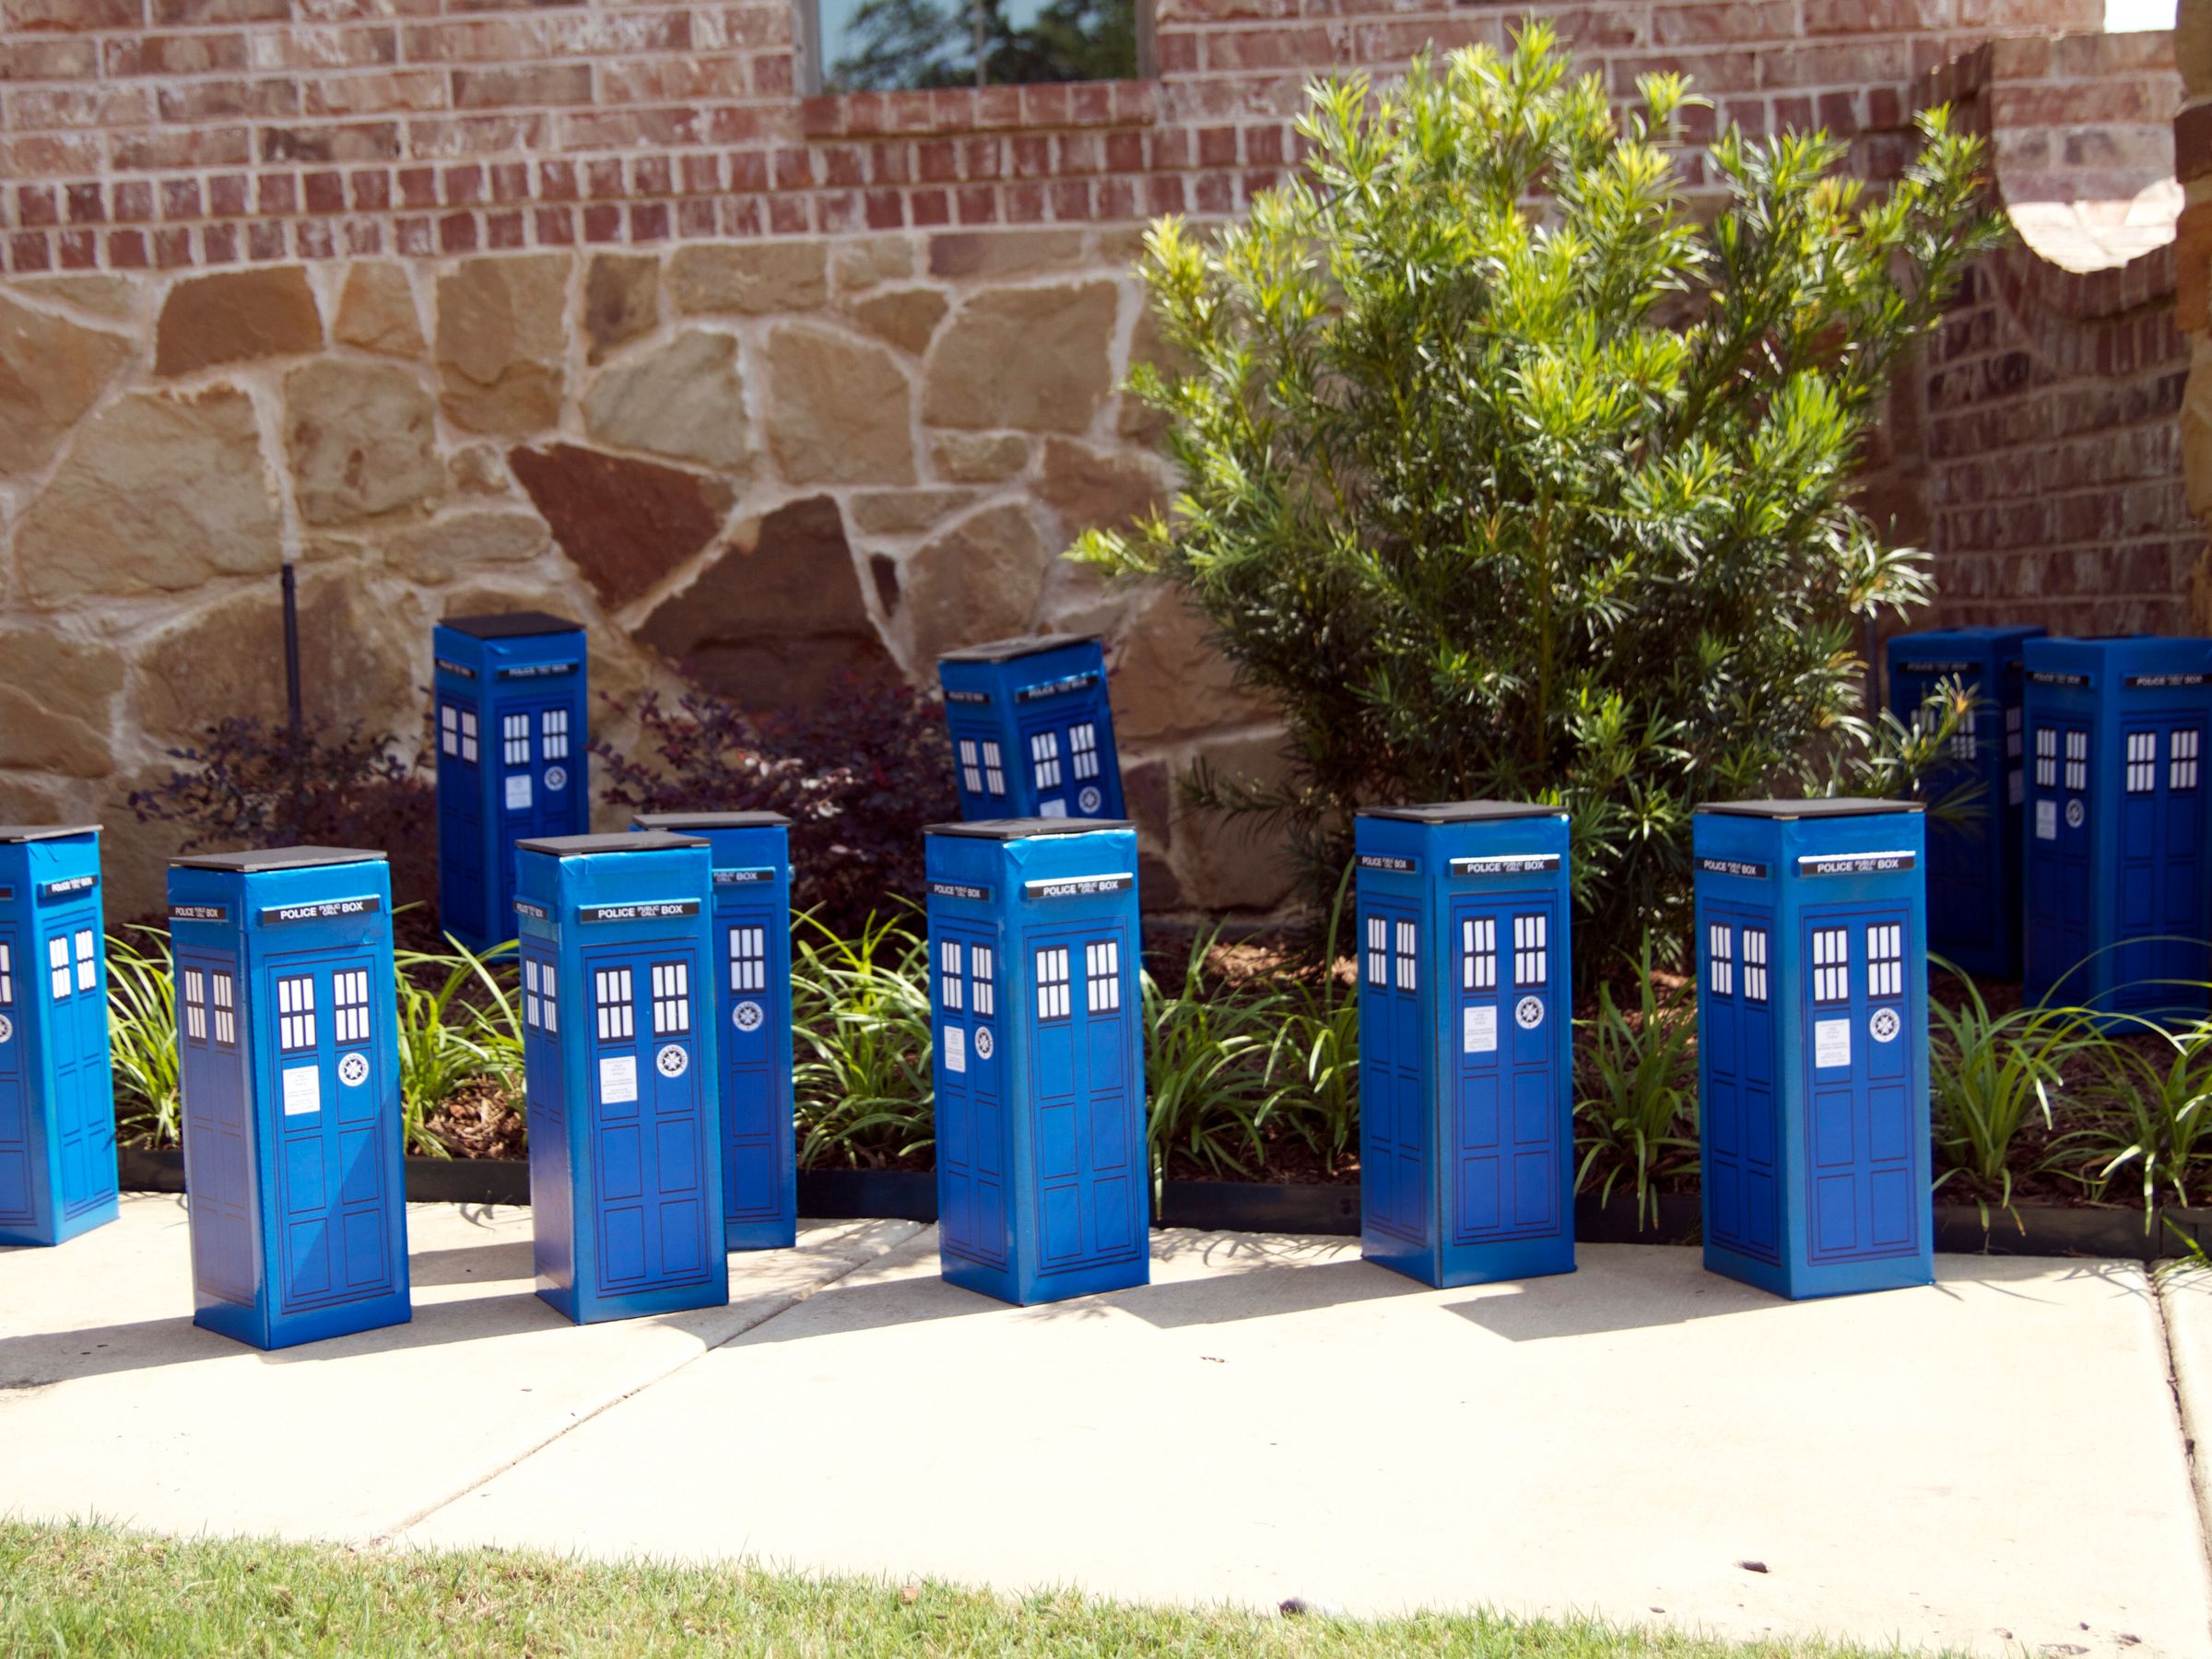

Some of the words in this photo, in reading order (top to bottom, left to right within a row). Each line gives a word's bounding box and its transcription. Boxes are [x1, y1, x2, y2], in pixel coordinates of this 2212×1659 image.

[1467, 862, 1500, 874] POLICE
[1524, 861, 1545, 871] BOX
[1703, 859, 1726, 872] POLICE
[1741, 865, 1757, 876] BOX
[1817, 861, 1853, 874] POLICE
[1877, 858, 1900, 870] BOX
[735, 872, 758, 881] BOX
[934, 884, 955, 896] POLICE
[967, 888, 981, 899] BOX
[1042, 883, 1077, 896] POLICE
[1099, 880, 1119, 890] BOX
[175, 906, 194, 917] POLICE
[206, 908, 219, 918] BOX
[280, 906, 318, 920] POLICE
[342, 901, 364, 912] BOX
[598, 907, 636, 919] POLICE
[661, 904, 684, 914] BOX
